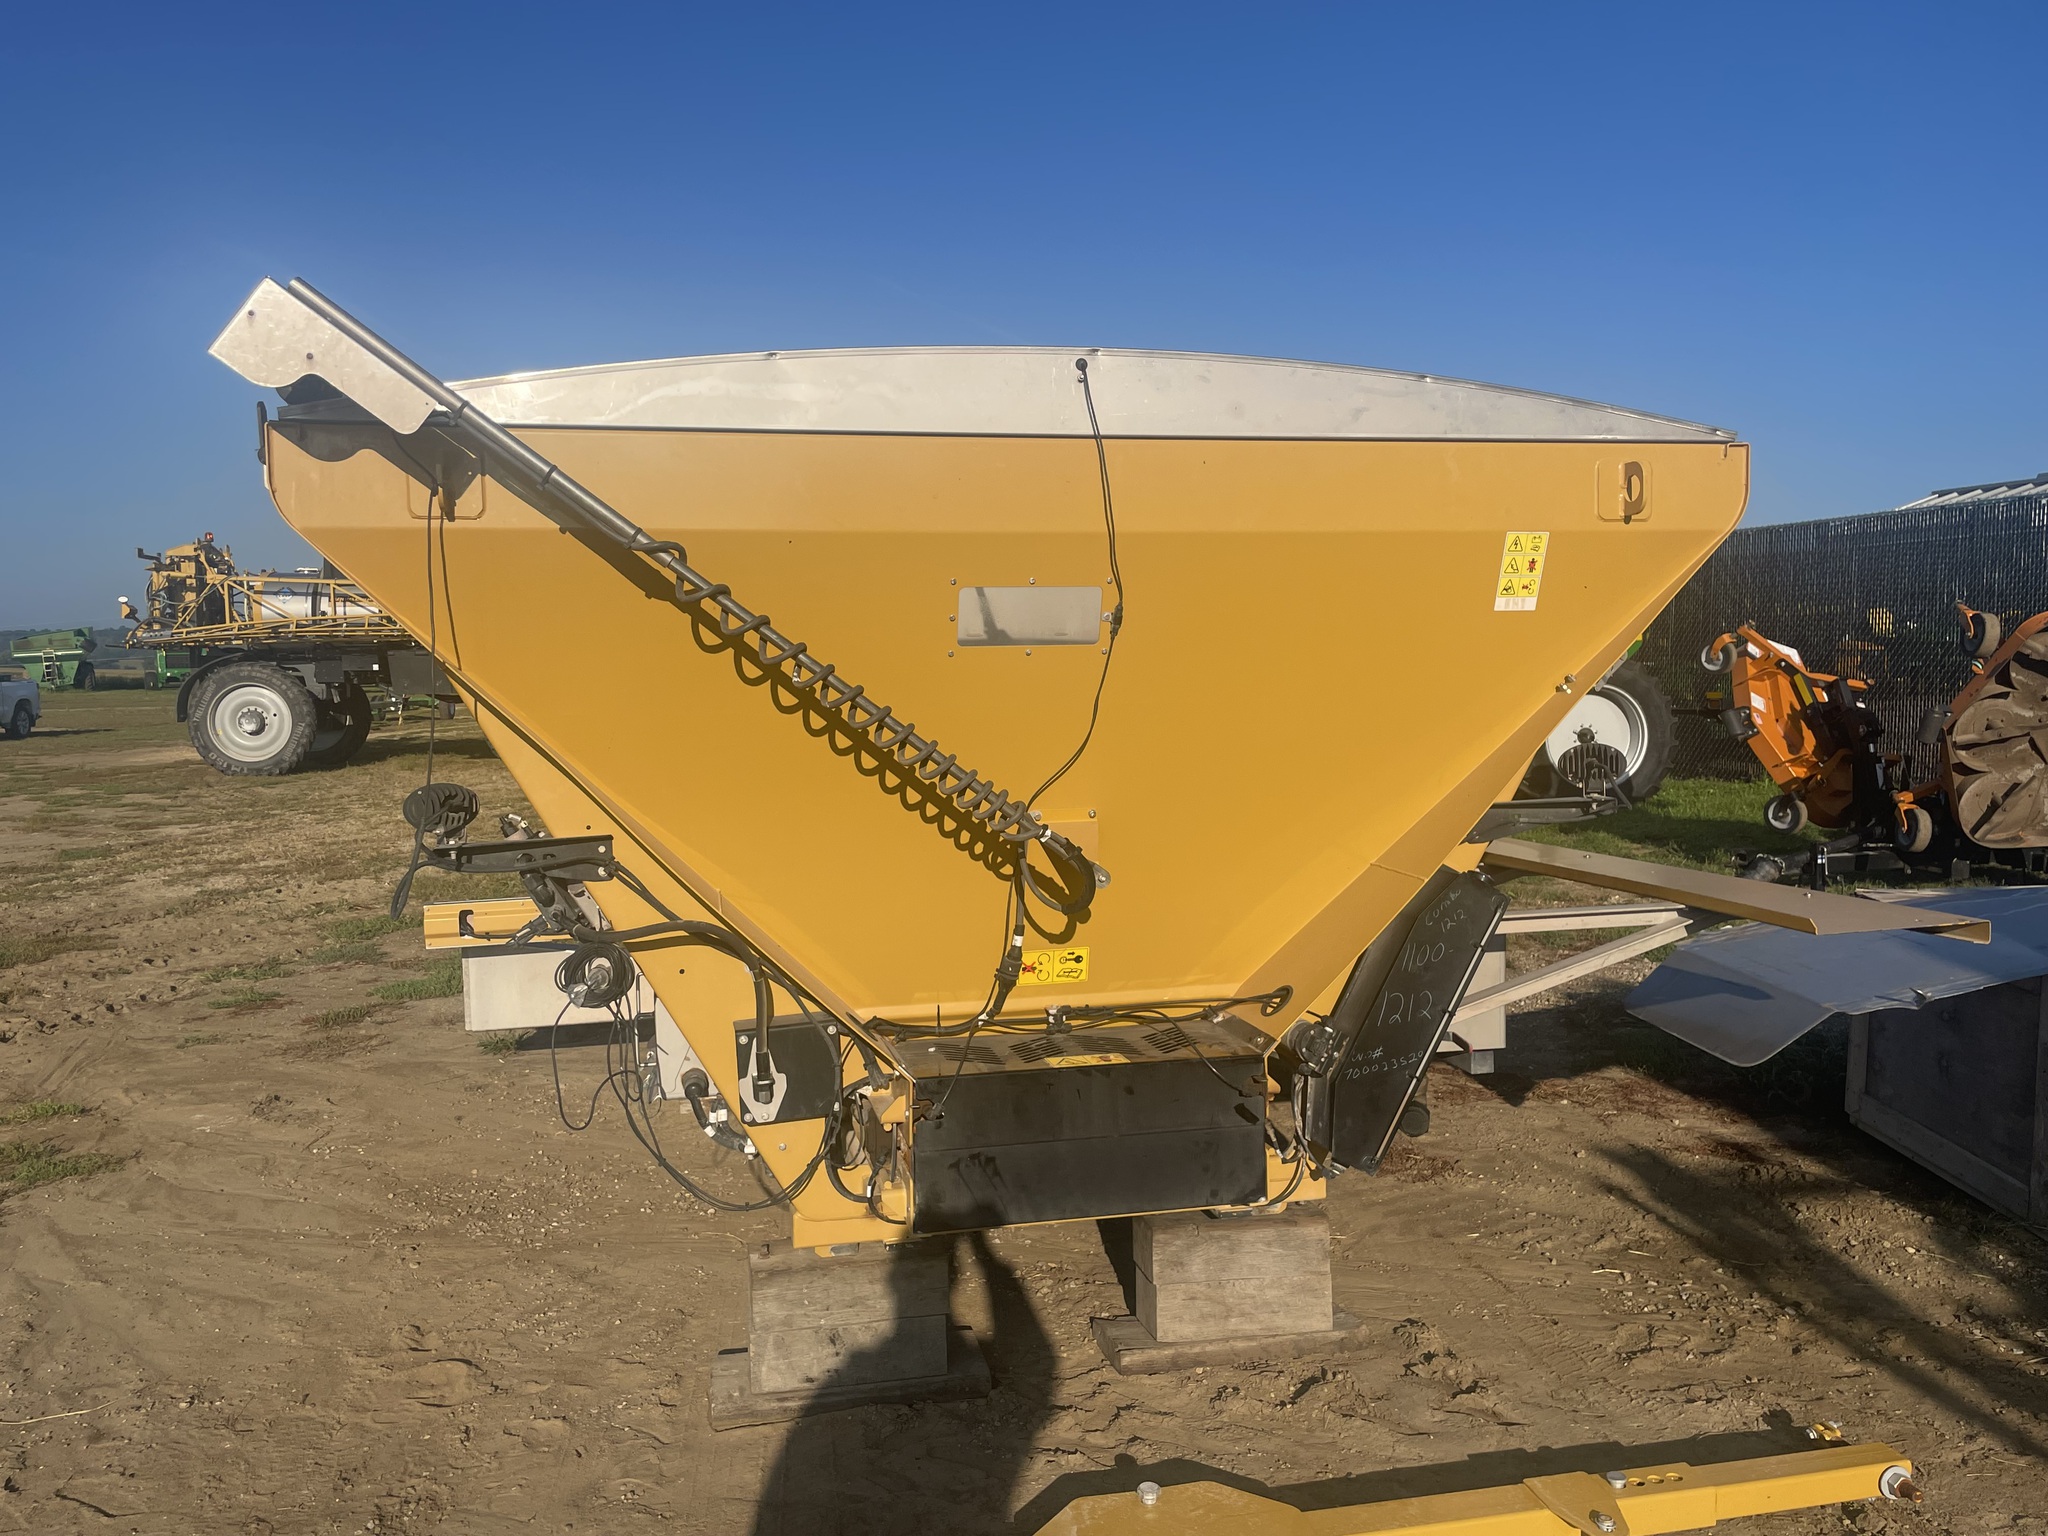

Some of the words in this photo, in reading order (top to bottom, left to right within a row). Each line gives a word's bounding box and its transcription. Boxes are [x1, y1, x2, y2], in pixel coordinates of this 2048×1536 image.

[193, 680, 217, 722] TRELLEBORG
[1440, 909, 1468, 933] 1212
[1377, 990, 1433, 1027] 1212
